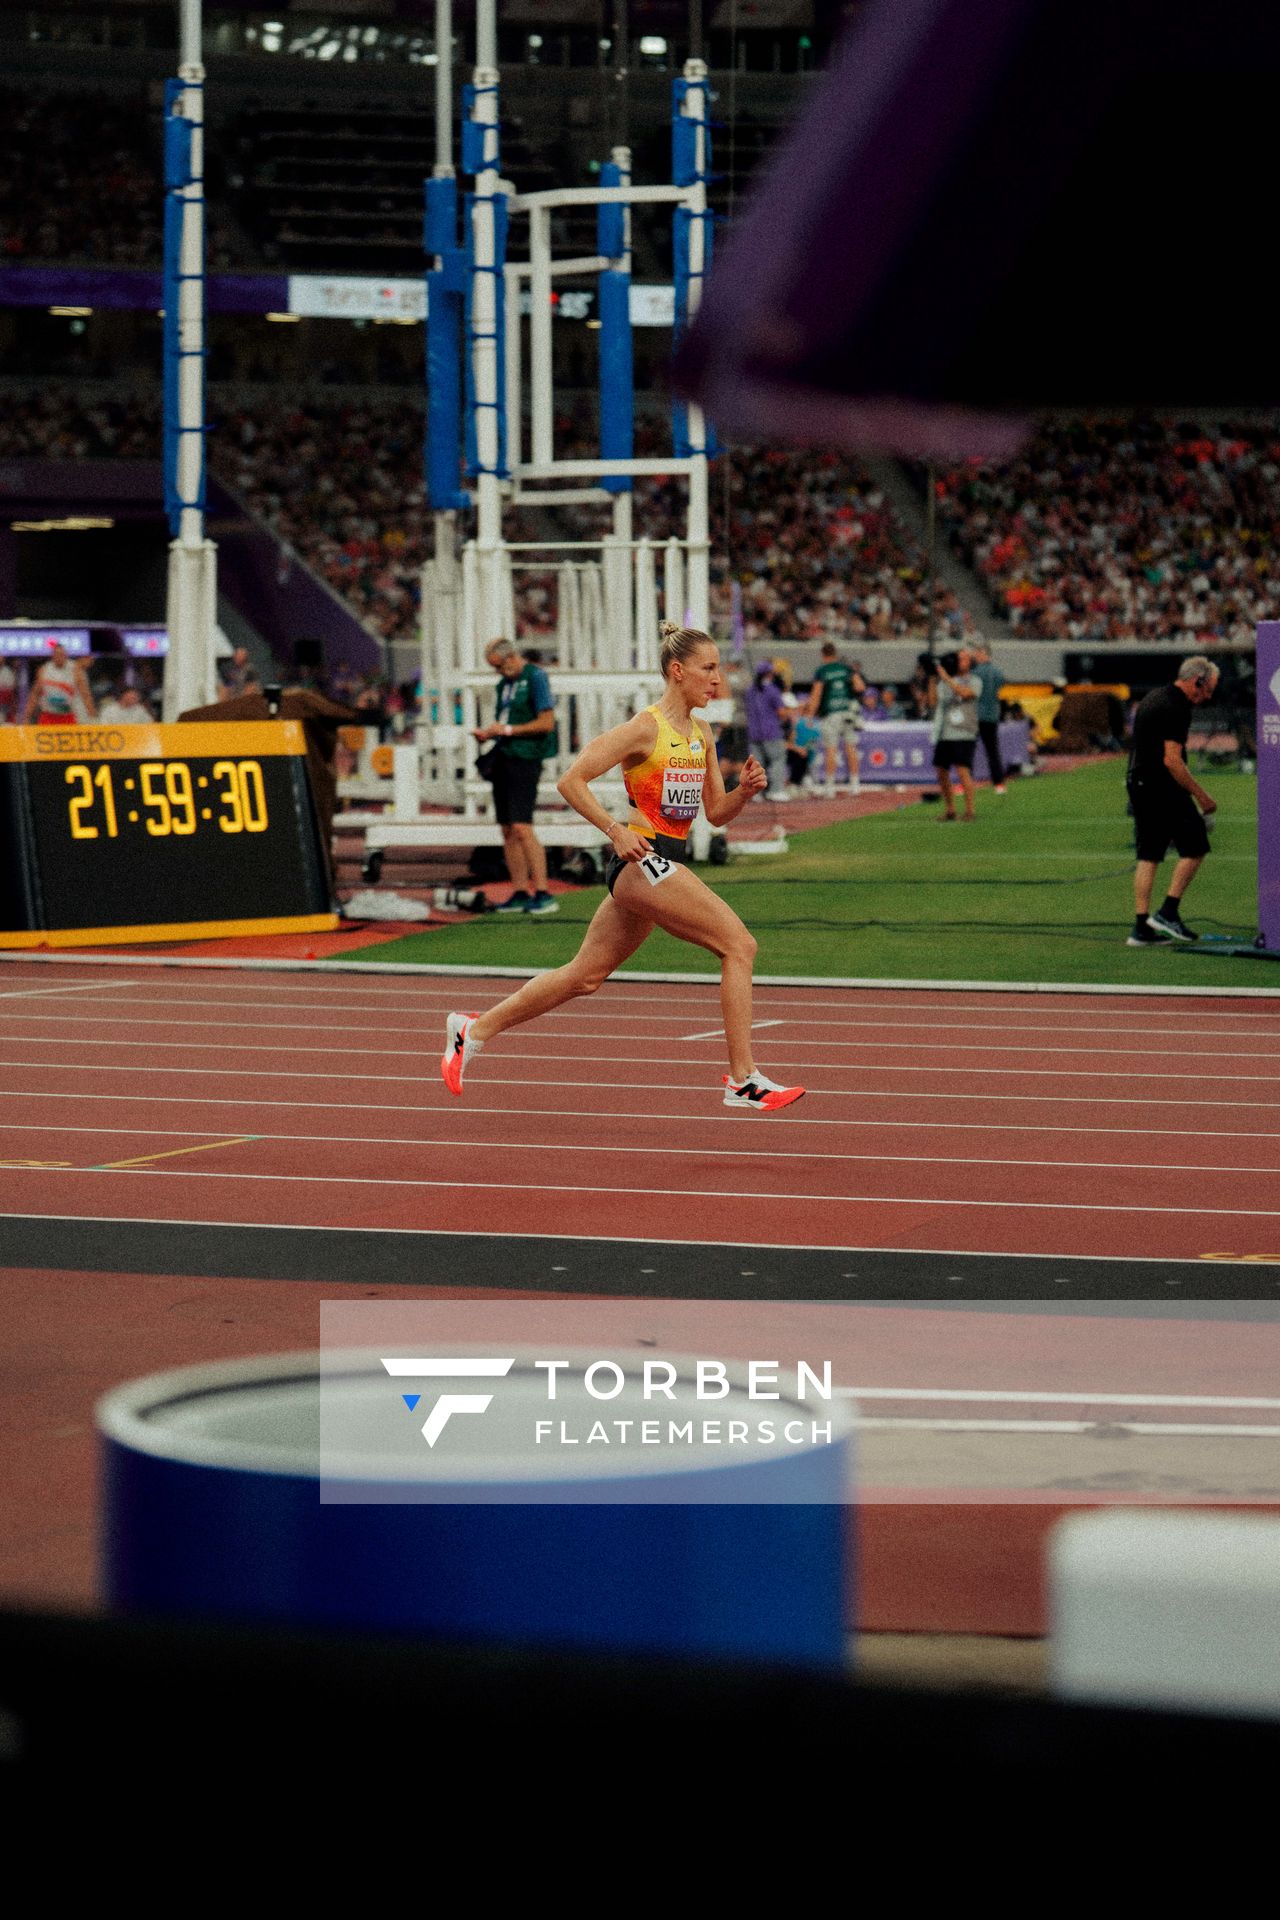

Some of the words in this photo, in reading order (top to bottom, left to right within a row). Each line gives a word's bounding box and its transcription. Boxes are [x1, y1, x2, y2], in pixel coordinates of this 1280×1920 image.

[35, 730, 126, 753] SEIKO
[665, 772, 705, 783] HOND
[65, 760, 268, 839] 21:59:30
[642, 856, 670, 878] 13
